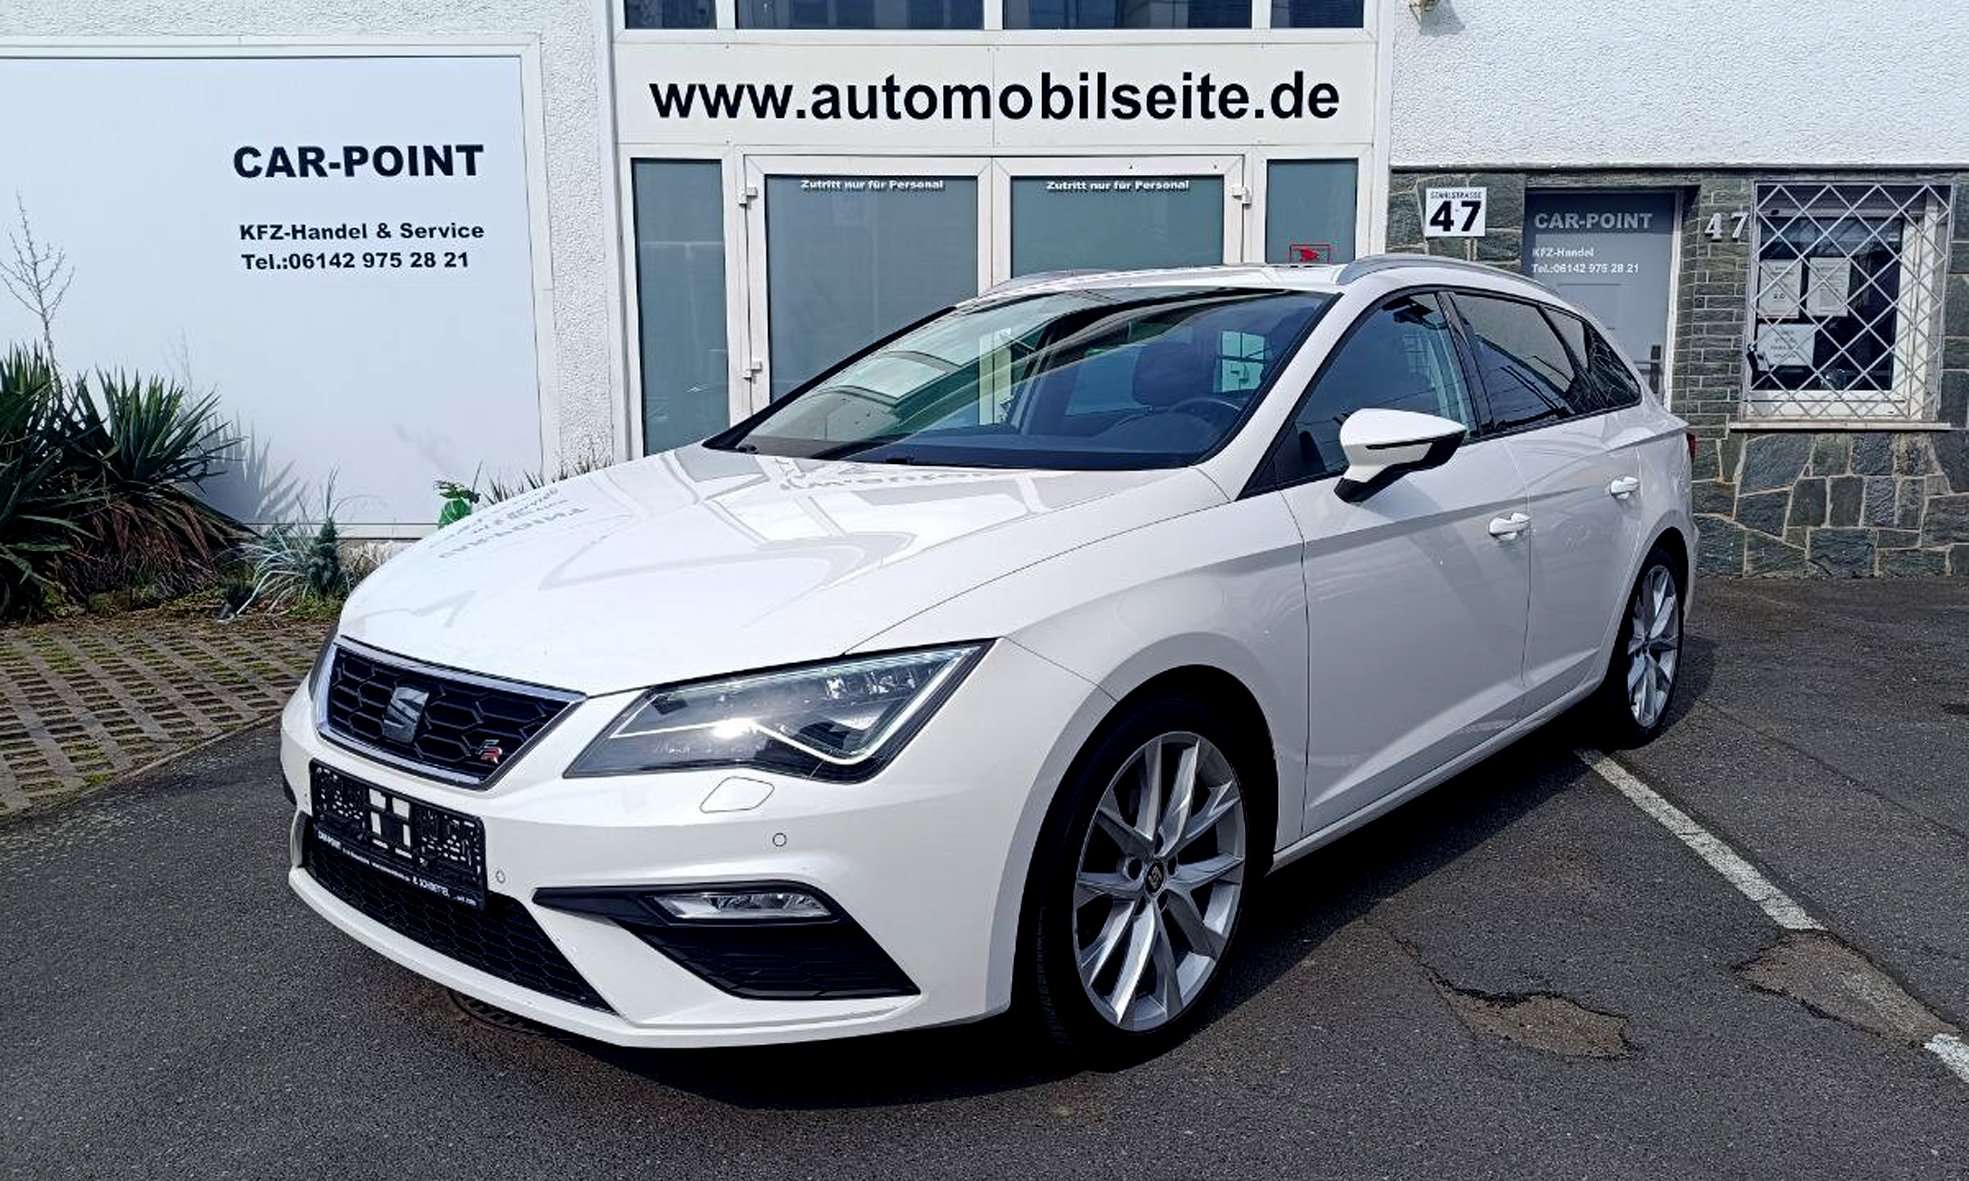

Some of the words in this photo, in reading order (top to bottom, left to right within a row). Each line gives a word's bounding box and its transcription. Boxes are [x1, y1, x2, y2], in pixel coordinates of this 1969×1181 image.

[649, 71, 1339, 120] www.automobilseite.de
[234, 145, 483, 178] CAR-POINT
[800, 180, 841, 190] Zutritt
[844, 181, 865, 190] nur
[868, 180, 886, 190] für
[889, 180, 944, 190] Personal
[1046, 180, 1087, 190] Zutritt
[1090, 181, 1110, 190] nur
[1114, 180, 1132, 190] für
[1135, 180, 1190, 190] Personal
[1429, 200, 1481, 232] 47
[1534, 213, 1653, 229] CAR-POINT
[240, 224, 367, 241] KFZ-Handel
[377, 223, 391, 239] &
[400, 223, 484, 239] Service
[1704, 212, 1749, 239] 47
[241, 253, 355, 270] Tel.:06142
[363, 253, 402, 269] 975
[410, 252, 436, 268] 28
[444, 252, 468, 268] 21
[1532, 247, 1595, 257] KFZ-Handel
[1532, 263, 1586, 273] Tel.:06142
[1611, 263, 1624, 273] 28
[1627, 263, 1640, 273] 21
